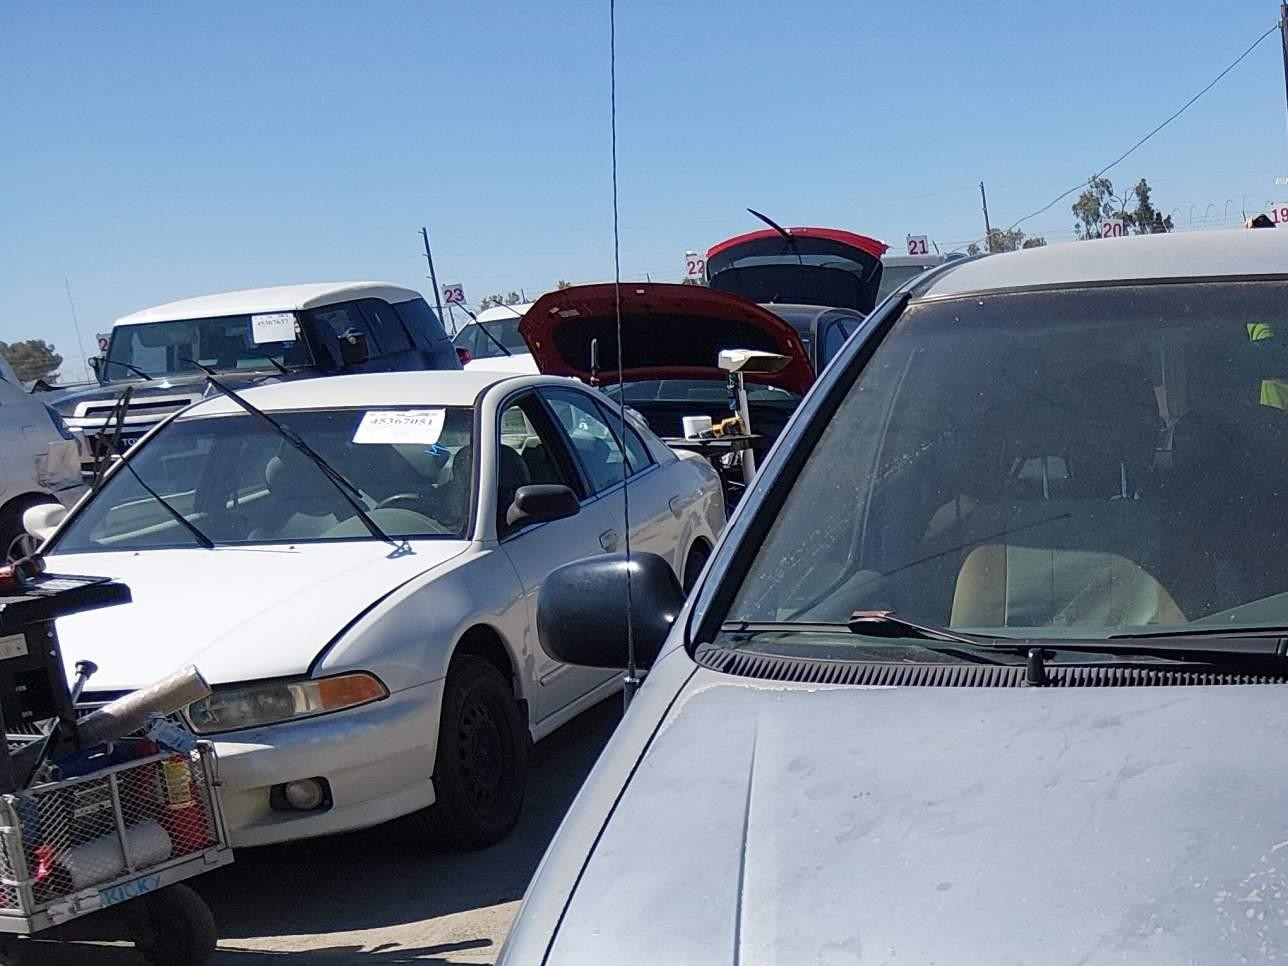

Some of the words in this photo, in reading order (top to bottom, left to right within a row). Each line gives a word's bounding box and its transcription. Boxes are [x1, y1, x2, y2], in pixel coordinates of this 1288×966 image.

[1103, 222, 1122, 238] 20
[908, 239, 929, 255] 21
[687, 259, 705, 275] 22
[444, 287, 465, 303] 23
[104, 873, 161, 905] RICKY
